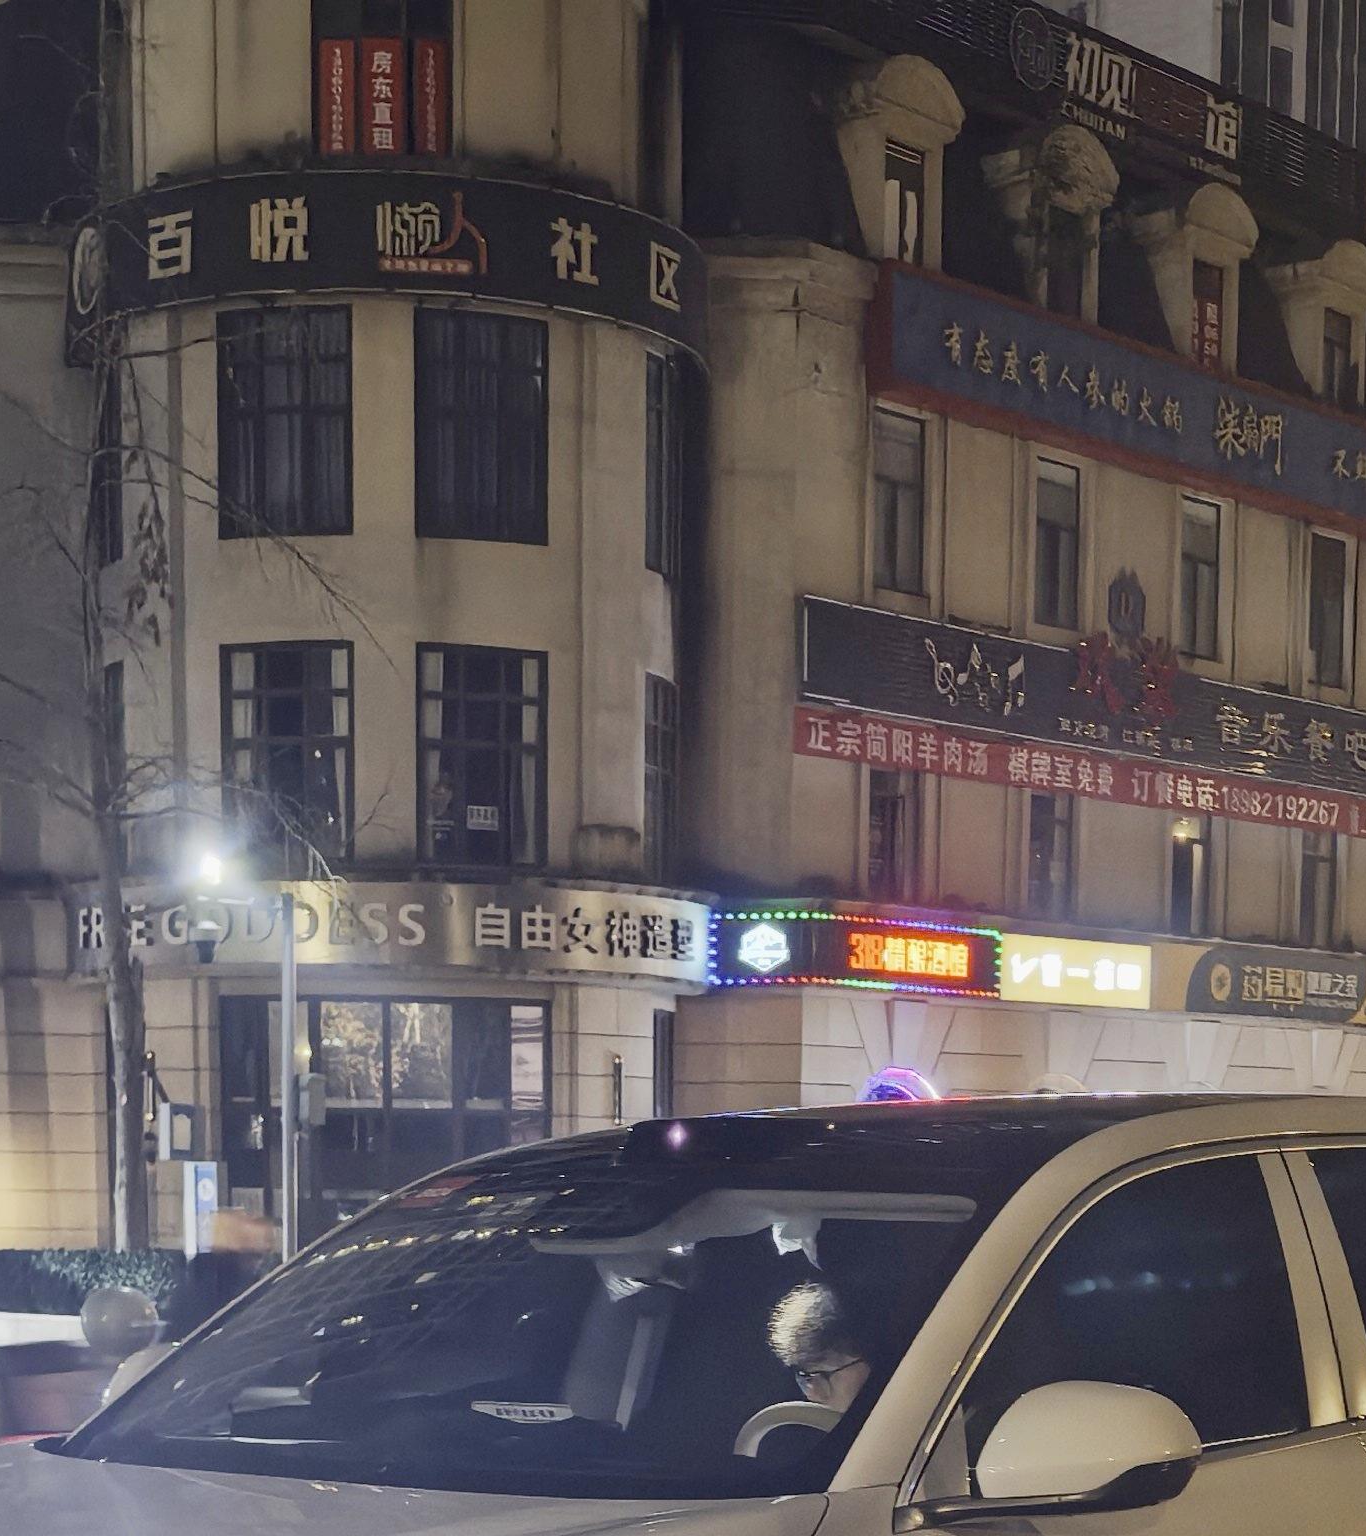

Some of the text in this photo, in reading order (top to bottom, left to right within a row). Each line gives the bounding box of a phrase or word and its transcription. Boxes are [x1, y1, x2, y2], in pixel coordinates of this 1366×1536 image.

[371, 51, 394, 150] 房东直租
[807, 716, 990, 776] 正宗简阳羊肉汤
[79, 905, 148, 947] FRE
